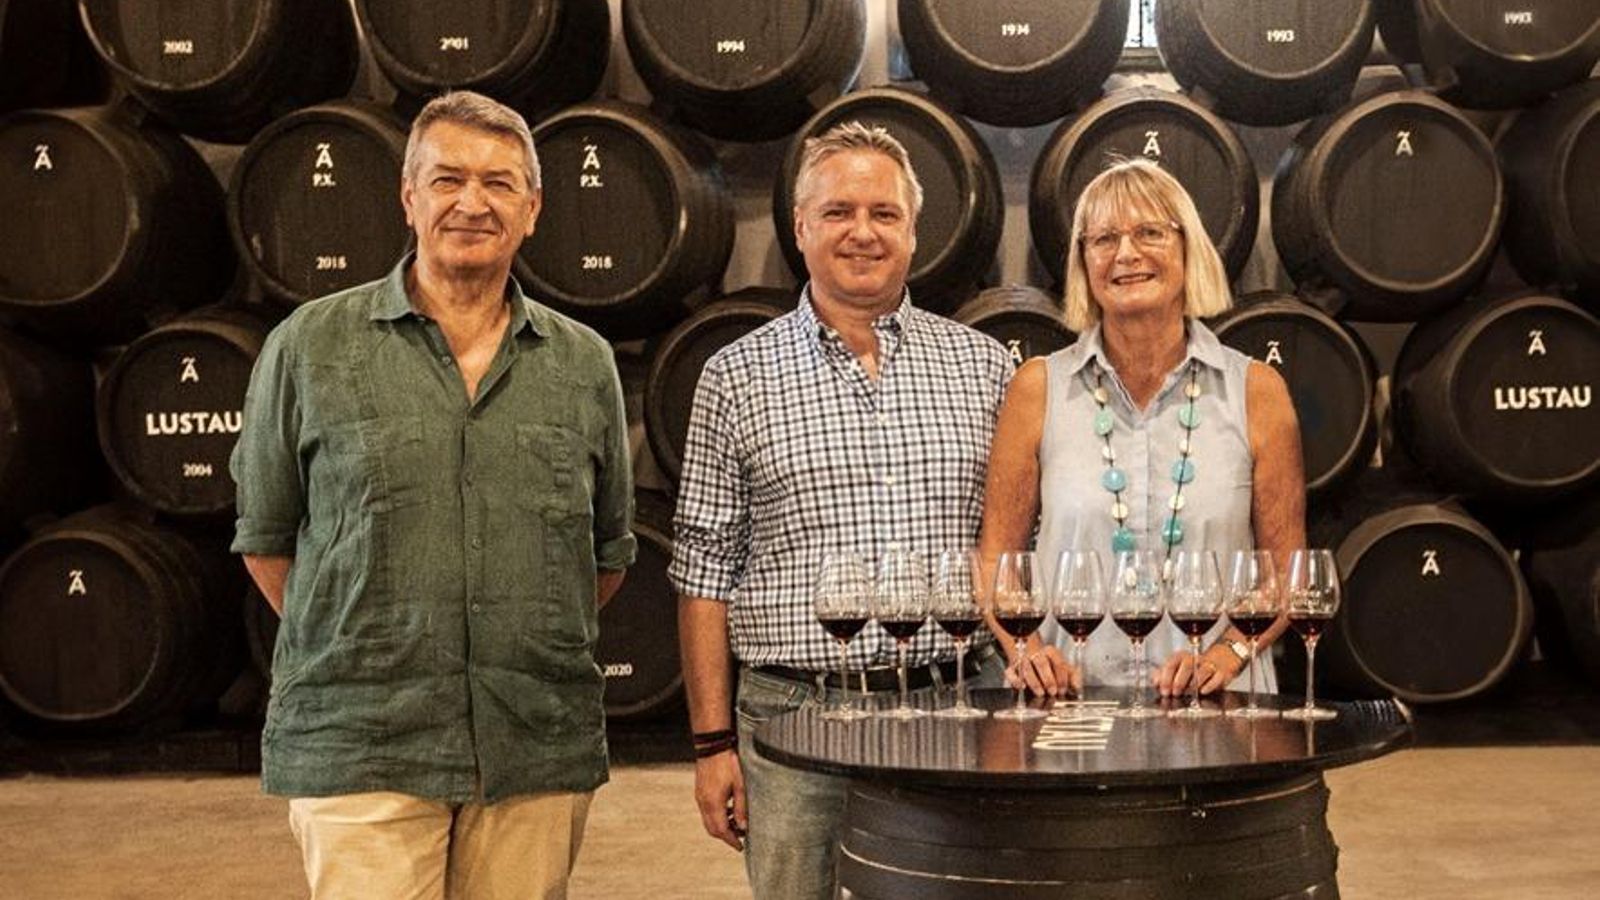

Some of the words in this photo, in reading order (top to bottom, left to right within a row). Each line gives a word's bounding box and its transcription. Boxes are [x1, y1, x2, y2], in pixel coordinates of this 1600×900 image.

[1504, 11, 1532, 24] 1993
[163, 40, 193, 54] 2002
[717, 40, 745, 53] 1994
[1267, 29, 1295, 42] 1993
[1142, 131, 1161, 155] Ã
[1395, 131, 1413, 155] Ã
[34, 145, 52, 169] Ã
[315, 143, 334, 168] Ã
[583, 144, 601, 170] Ã
[582, 256, 612, 270] 2018
[1528, 330, 1546, 355] Ã
[181, 357, 199, 382] Ã
[1494, 385, 1591, 411] LUSTAU
[145, 410, 243, 436] LUSTAU
[183, 463, 213, 477] 2004
[1422, 551, 1440, 576] Ã
[68, 570, 87, 595] Ã
[604, 662, 634, 677] 2020
